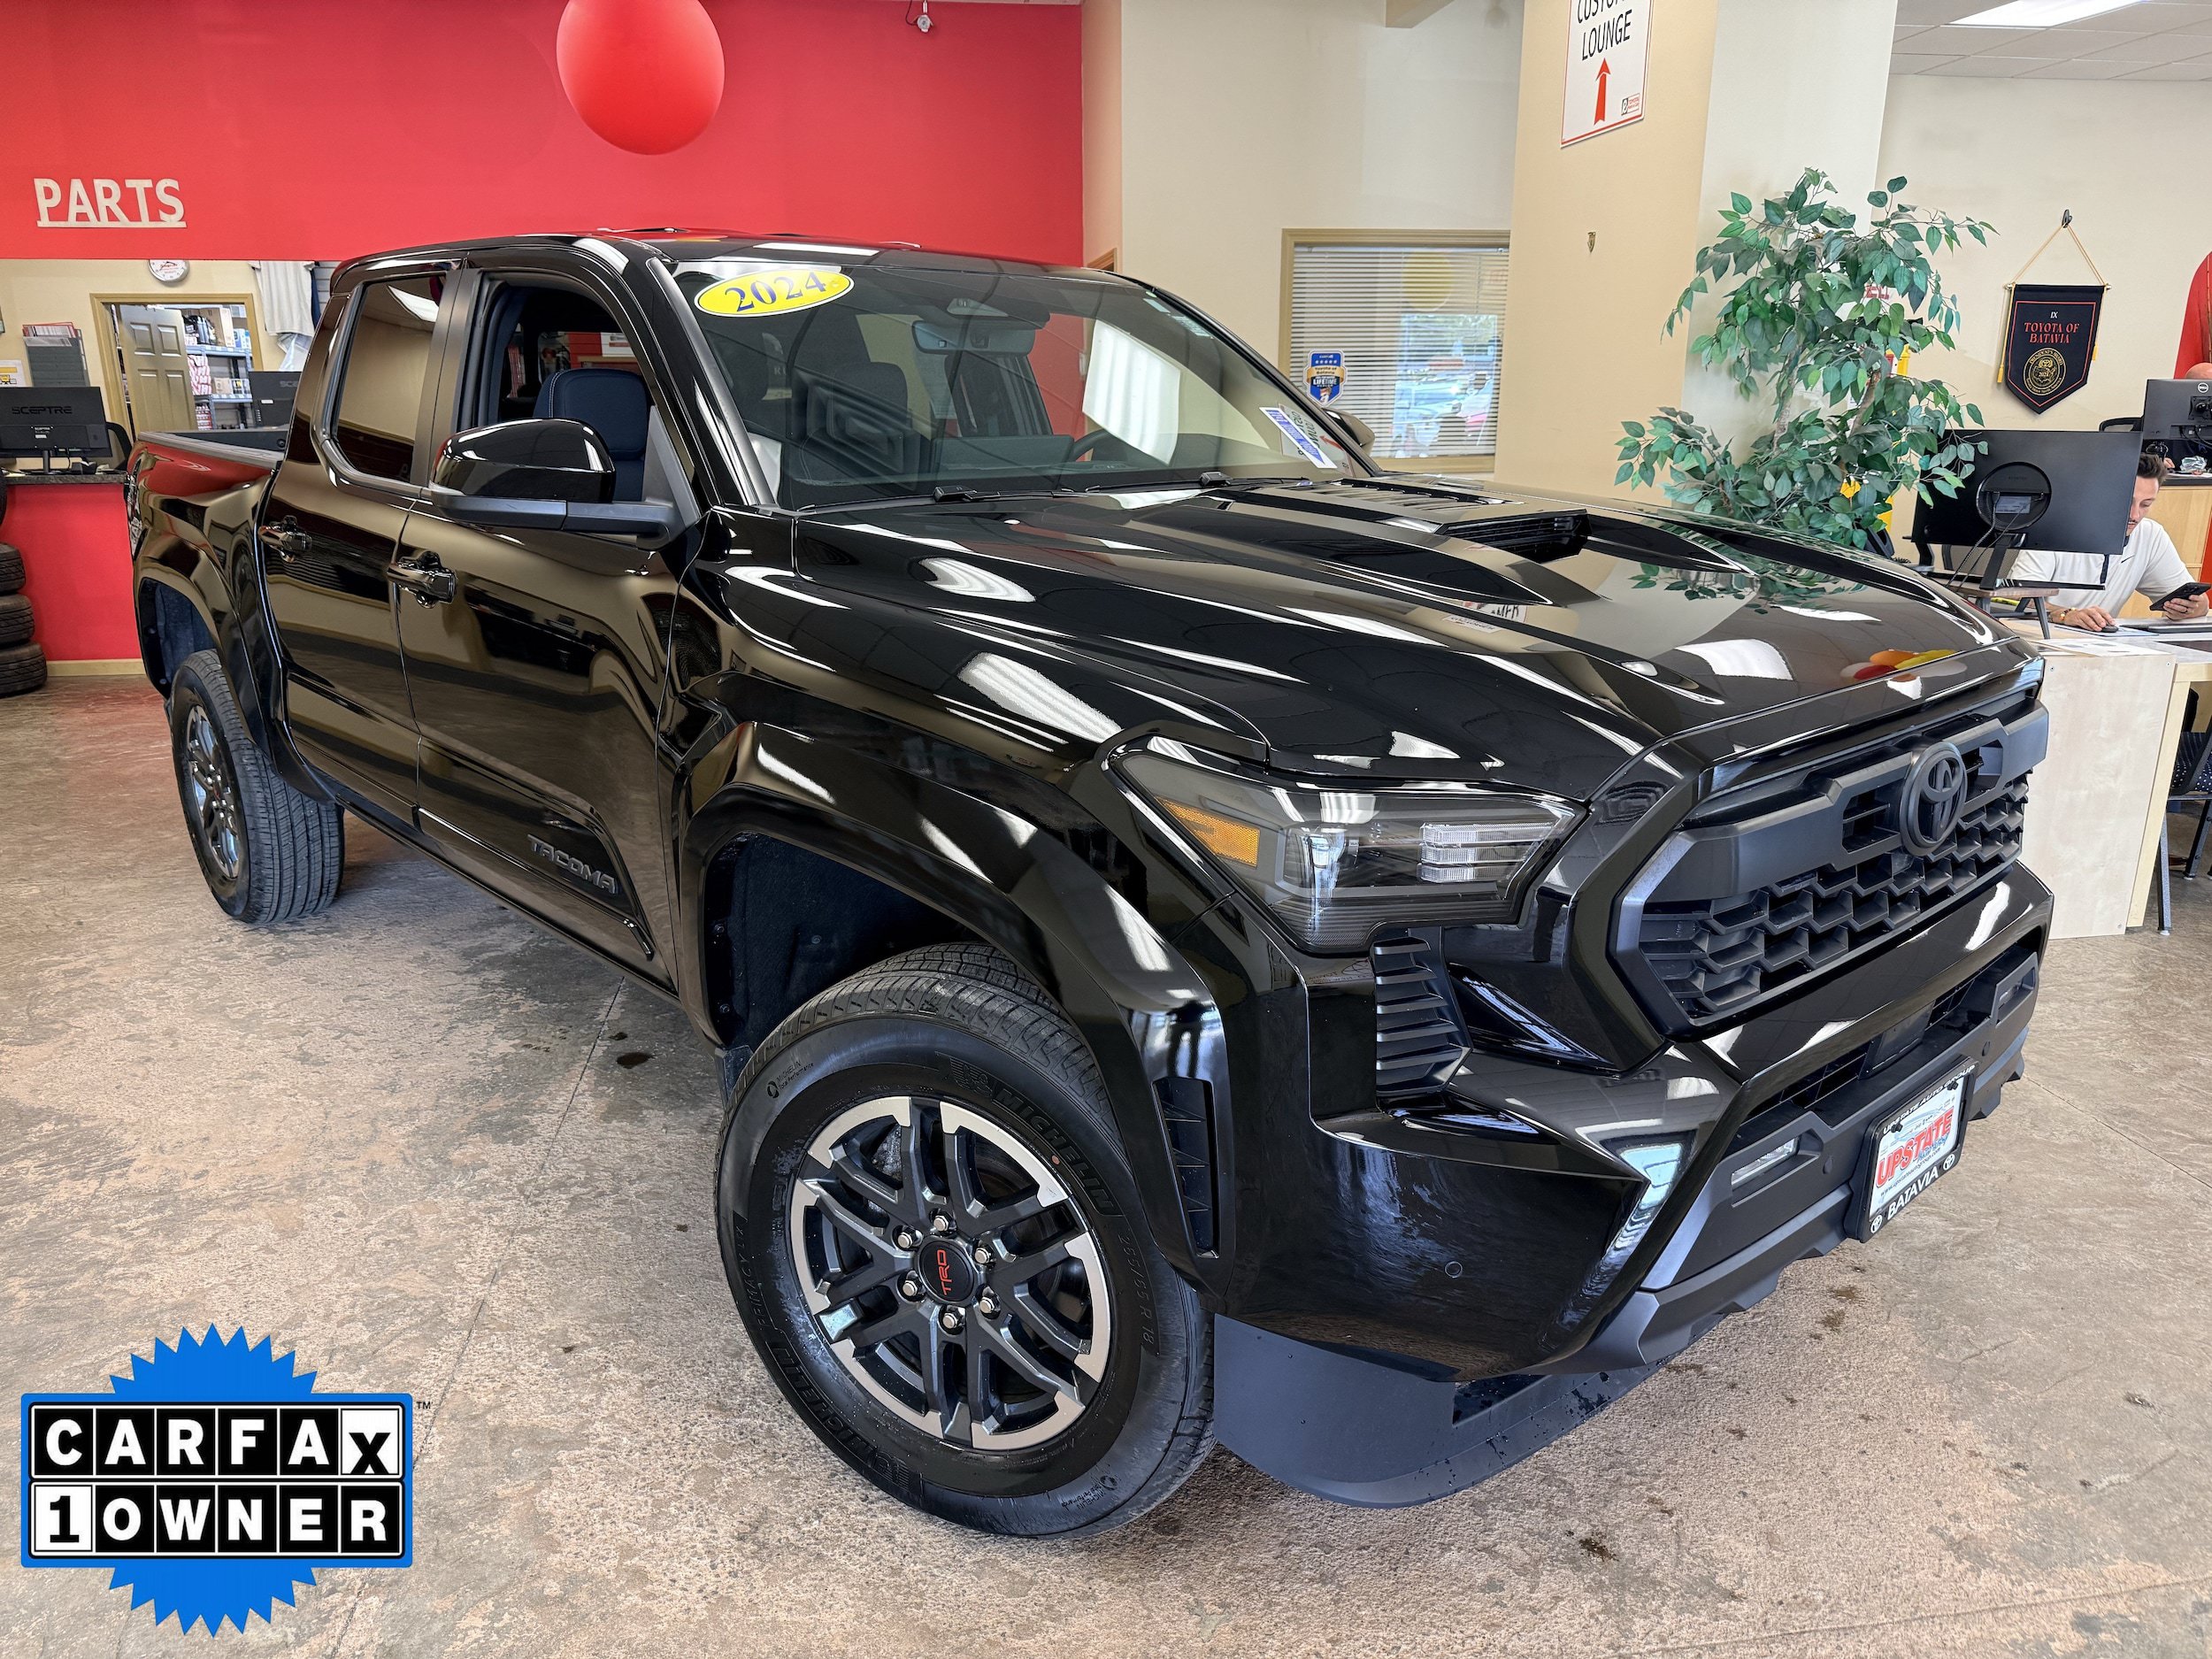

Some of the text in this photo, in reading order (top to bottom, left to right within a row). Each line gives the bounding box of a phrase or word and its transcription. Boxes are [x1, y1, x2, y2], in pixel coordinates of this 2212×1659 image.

[1582, 9, 1632, 61] LOUNGE
[34, 178, 185, 224] PARTS
[725, 272, 826, 312] 2024
[2050, 311, 2059, 319] IX
[2024, 322, 2080, 334] TOYOTA OF
[2029, 333, 2070, 344] BATAVIA
[12, 406, 73, 415] SCEPTRE
[527, 833, 616, 895] TACOMA
[1919, 1086, 1944, 1107] AUTO
[997, 1087, 1119, 1213] MICHELIN
[1876, 1106, 1955, 1188] UPSTATE
[1887, 1165, 1939, 1220] BATAVIA
[937, 1249, 953, 1296] TRD
